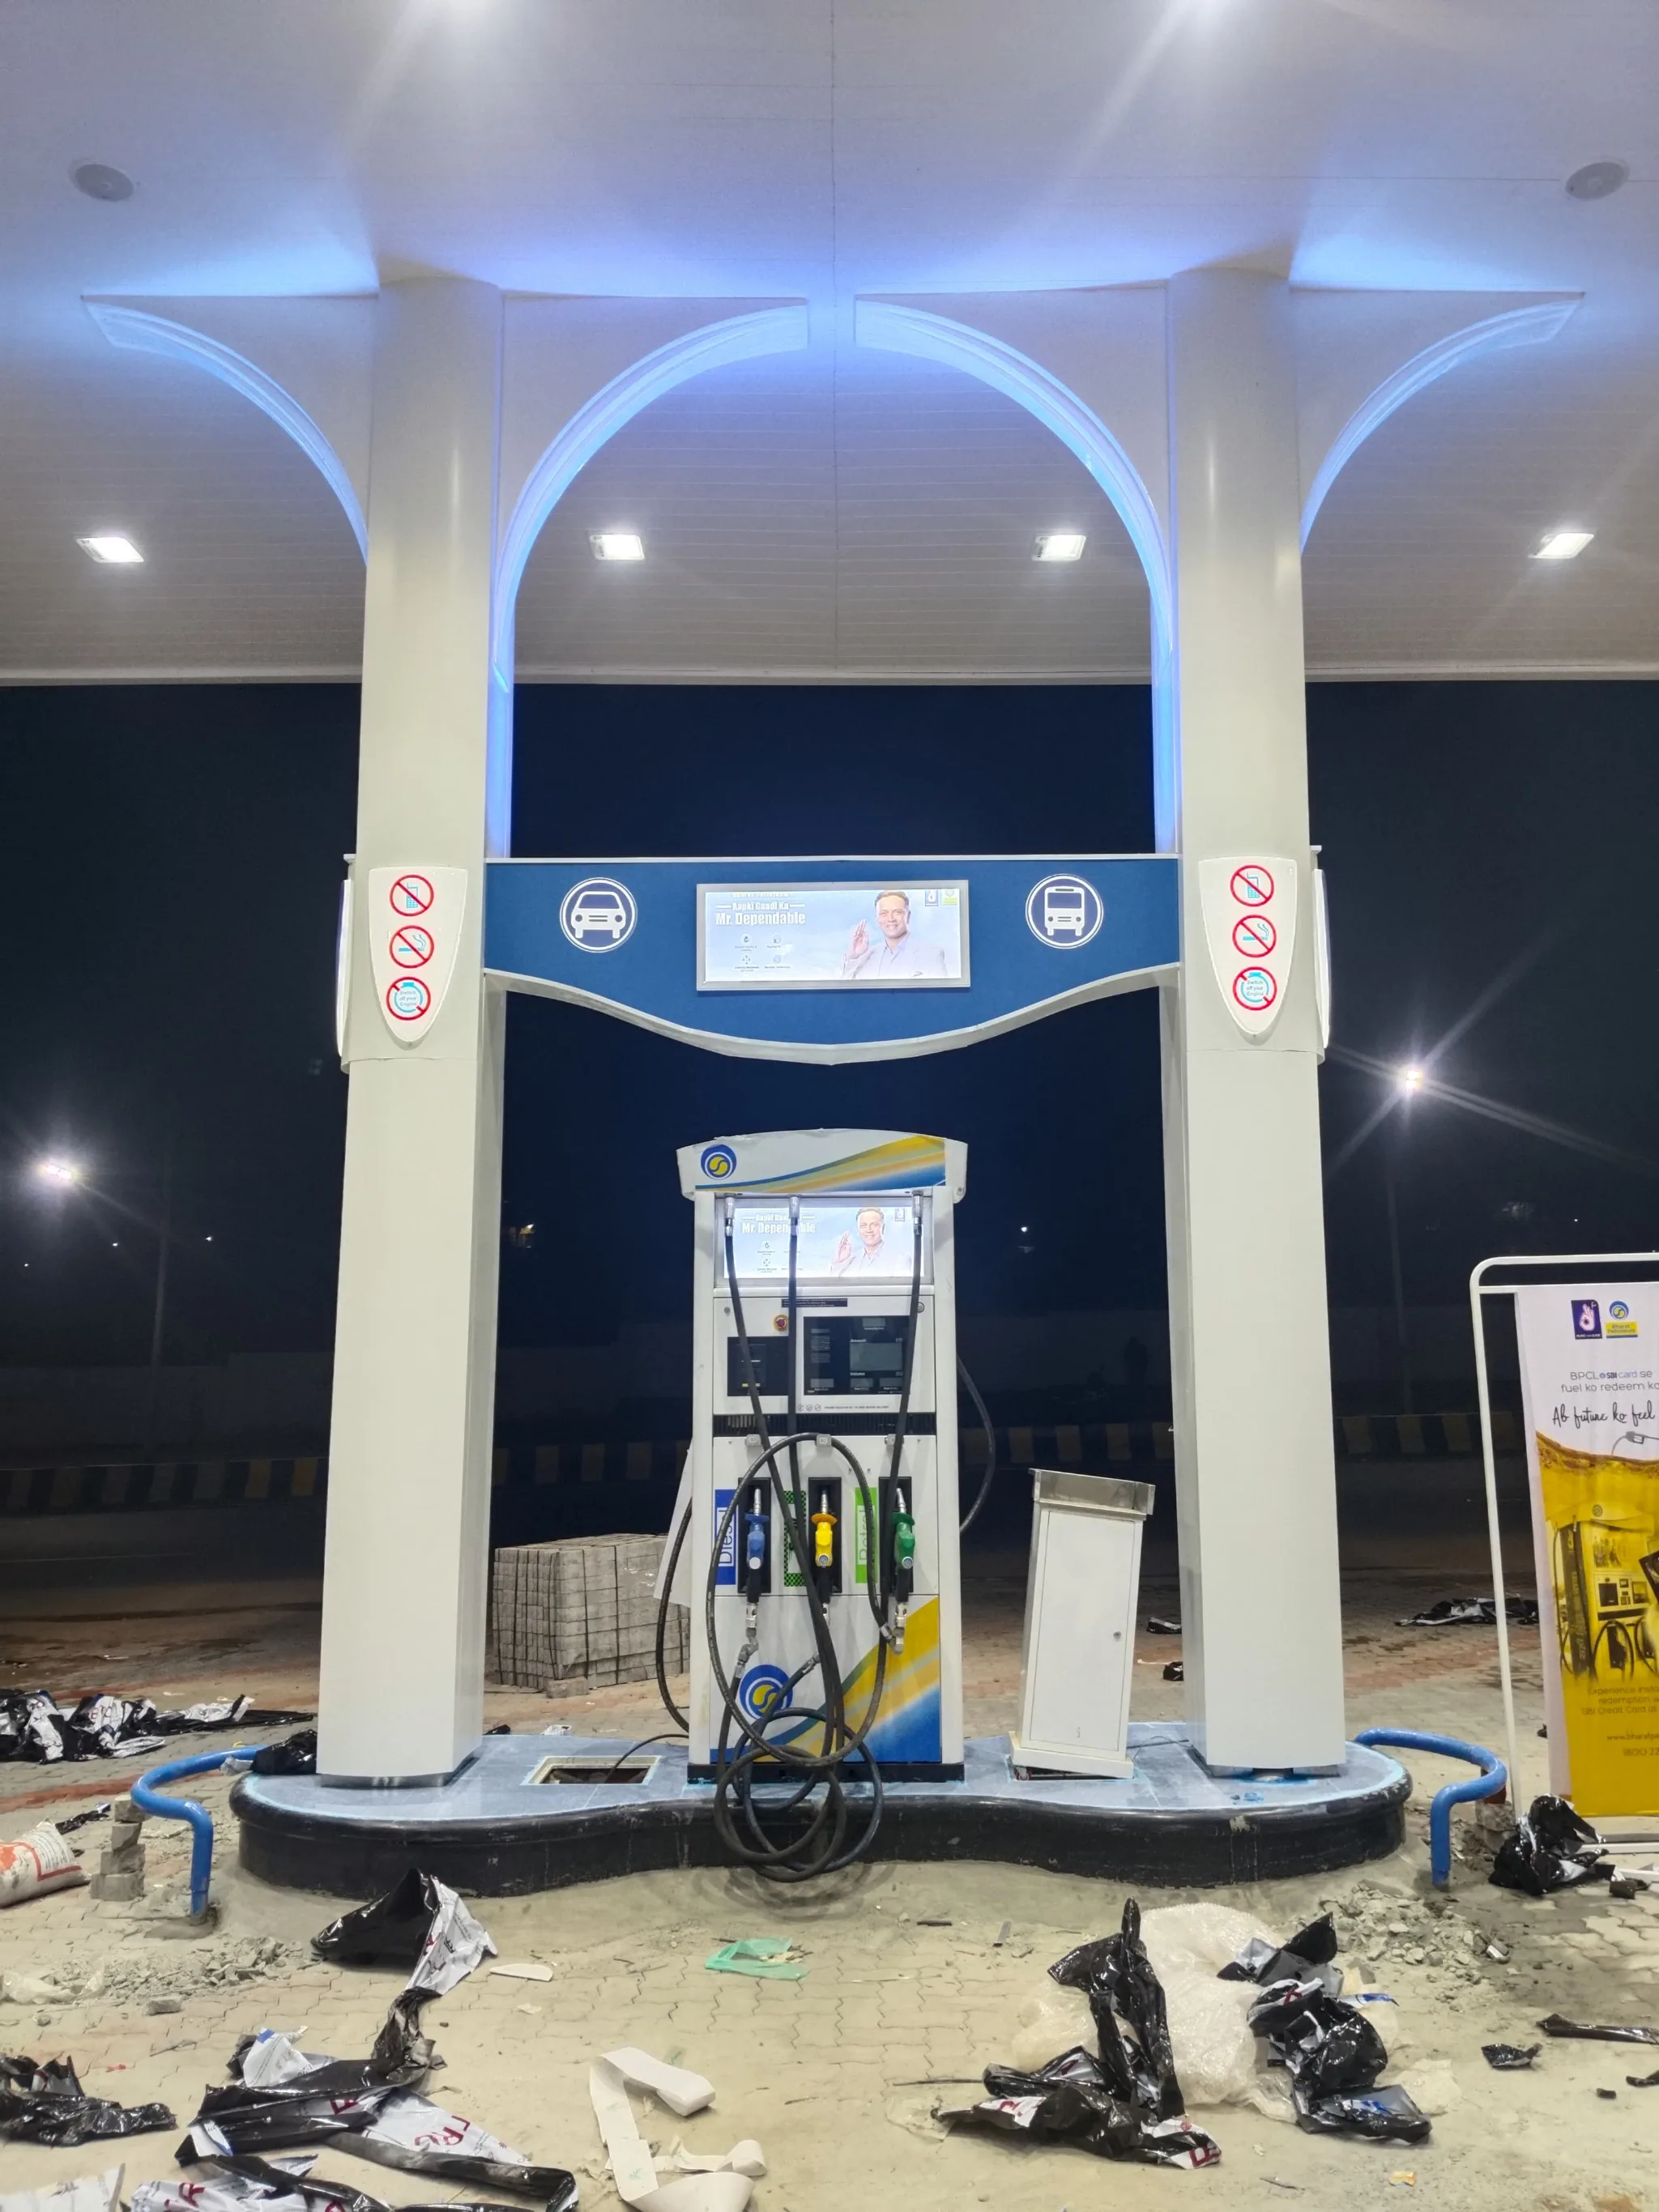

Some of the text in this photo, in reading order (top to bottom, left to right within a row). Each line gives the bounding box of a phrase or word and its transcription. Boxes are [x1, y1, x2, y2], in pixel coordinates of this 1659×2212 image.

[756, 902, 778, 910] Gaadi
[779, 901, 789, 910] Ka
[716, 912, 806, 925] Mr. Dependable
[742, 1223, 816, 1234] Mr. Depenble
[1570, 1370, 1599, 1380] BPCL
[1561, 1383, 1582, 1392] fuel
[1585, 1383, 1597, 1392] ko
[1601, 1382, 1645, 1391] redeem
[1552, 1400, 1655, 1429] Ab future ko feel
[719, 1509, 732, 1564] Diel
